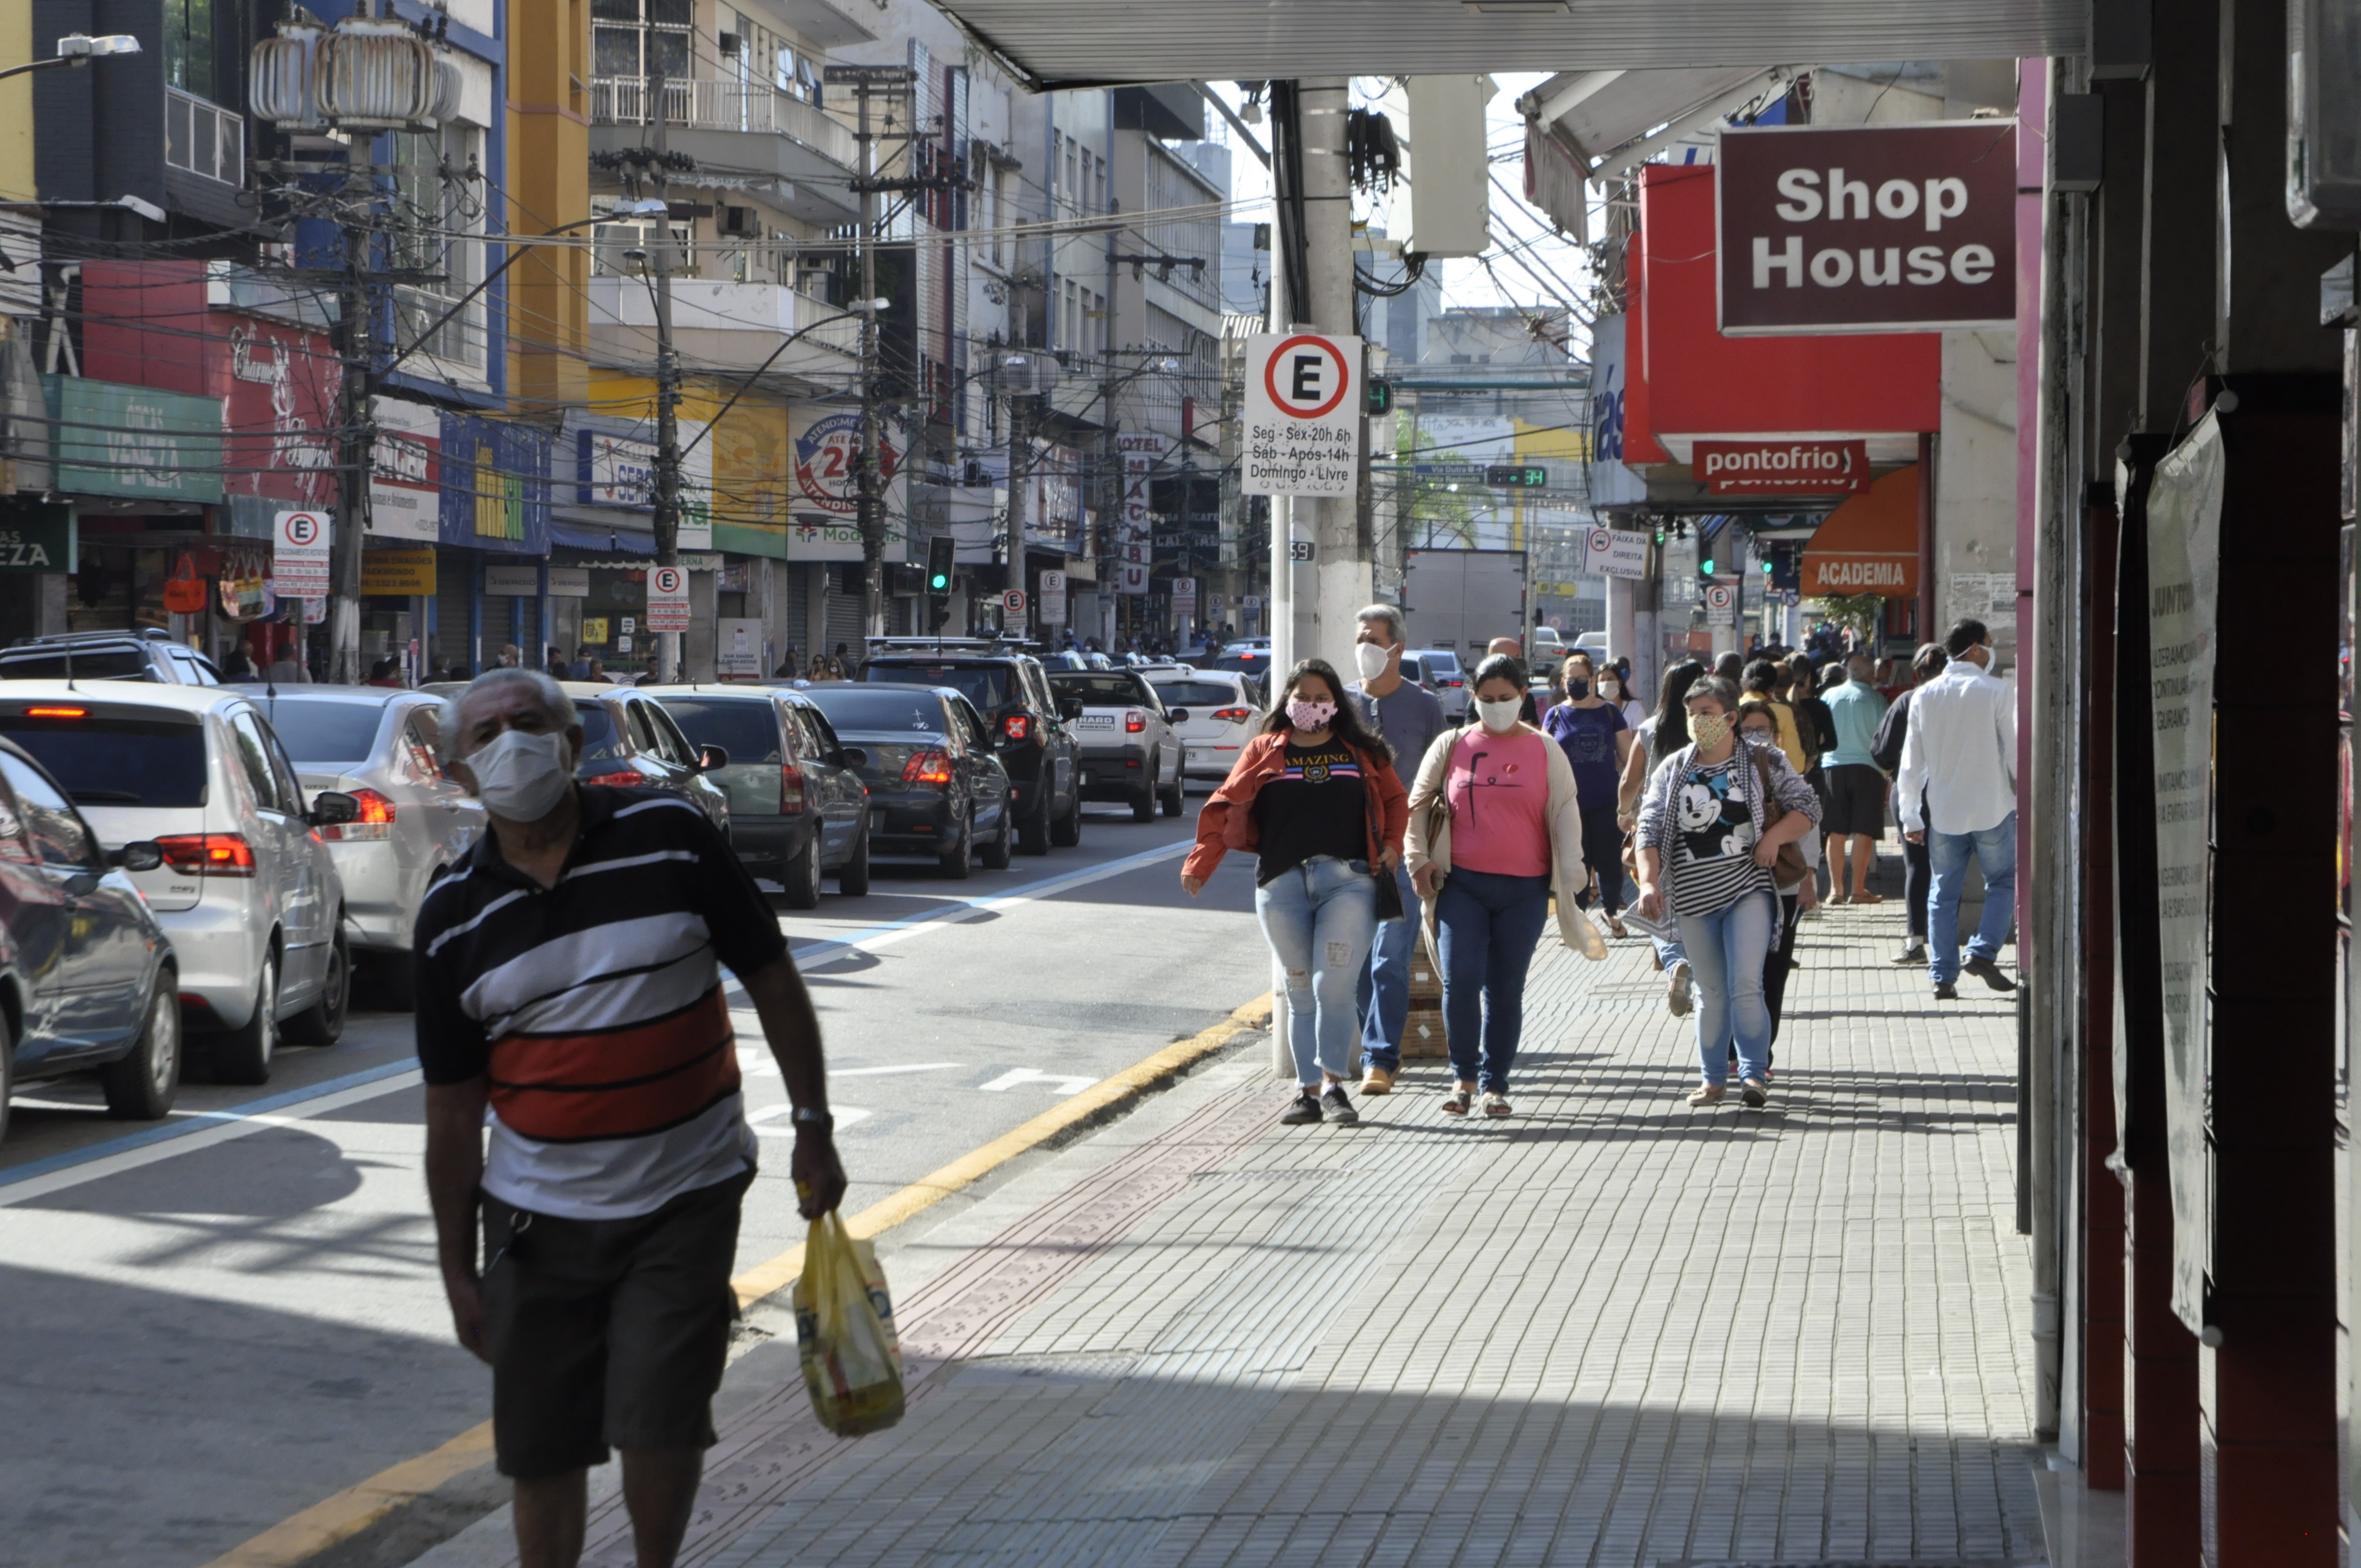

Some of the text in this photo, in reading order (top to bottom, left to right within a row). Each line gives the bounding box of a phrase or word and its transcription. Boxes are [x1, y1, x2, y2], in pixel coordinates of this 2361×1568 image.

[1776, 167, 1968, 232] Shop
[1752, 236, 1995, 288] House
[1292, 355, 1322, 400] E
[828, 433, 846, 444] ATÉ
[1253, 426, 1275, 443] Seg
[1286, 427, 1332, 441] Sex-20h
[1336, 428, 1351, 442] 6h
[1253, 442, 1277, 459] Sáb
[1288, 445, 1349, 462] Após-14h
[1706, 446, 1838, 475] pontofrio
[1250, 464, 1306, 482] Domingo
[1318, 466, 1348, 481] Livre
[1525, 470, 1544, 485] 34
[296, 520, 308, 538] E
[1128, 459, 1145, 586] MACABU
[0, 530, 21, 543] AS
[1612, 534, 1647, 546] FAIXA DA
[0, 543, 50, 566] EZA
[677, 556, 703, 566] DERNA
[1613, 550, 1643, 560] DIREITA
[1600, 564, 1643, 577] EXCLUSIVA
[1818, 562, 1905, 585] ACADEMIA
[662, 573, 672, 587] E
[1049, 576, 1056, 586] E
[1181, 581, 1187, 590] E
[1009, 594, 1019, 607] E
[1715, 591, 1722, 603] E
[2152, 582, 2195, 618] JUNTO
[1285, 754, 1349, 766] AMAZING
